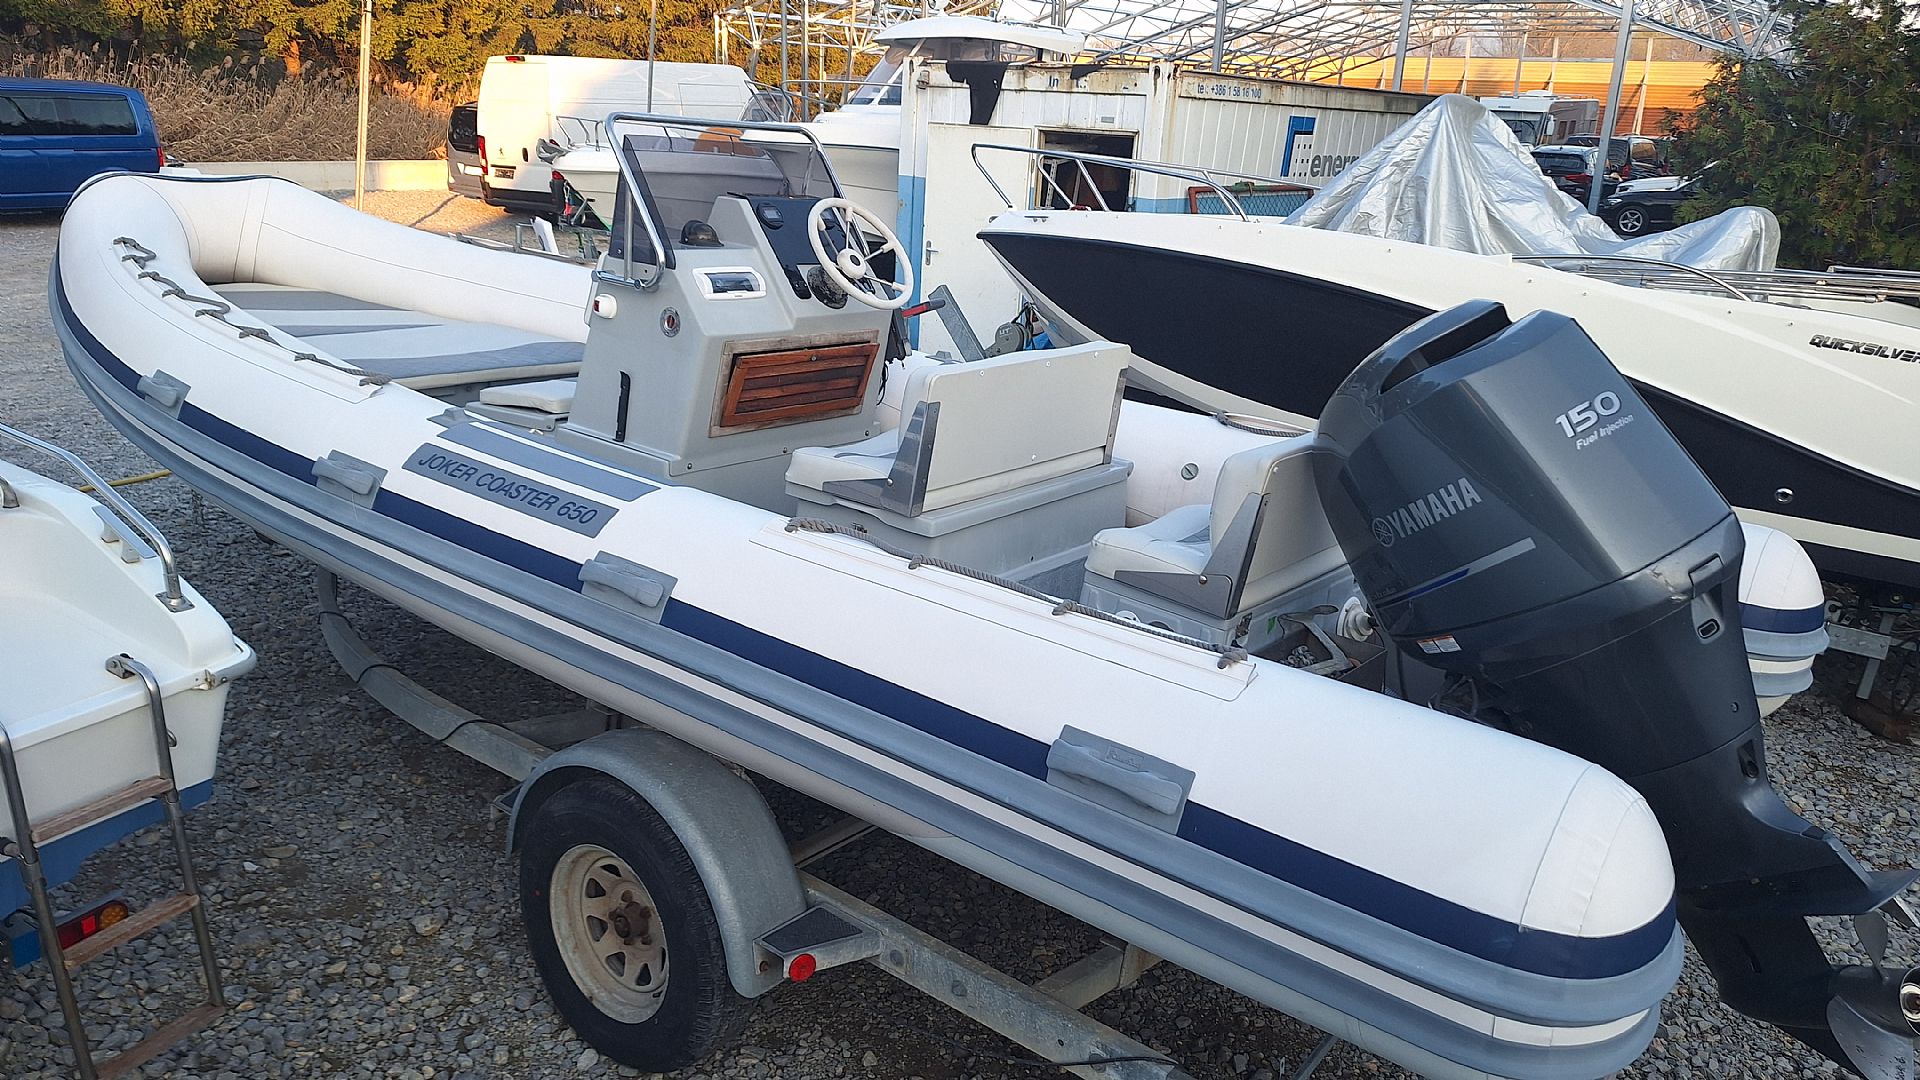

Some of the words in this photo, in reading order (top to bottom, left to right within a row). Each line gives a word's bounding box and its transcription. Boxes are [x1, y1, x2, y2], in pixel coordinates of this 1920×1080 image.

[1211, 84, 1226, 96] +386
[1228, 86, 1232, 97] 1
[1310, 154, 1360, 178] ener
[1555, 391, 1621, 438] 150
[1576, 430, 1598, 450] Fuel
[1599, 414, 1634, 438] Injection
[418, 453, 478, 482] JOKER
[475, 472, 560, 511] COASTER
[556, 501, 598, 524] 650
[1386, 477, 1482, 538] YAMAHA
